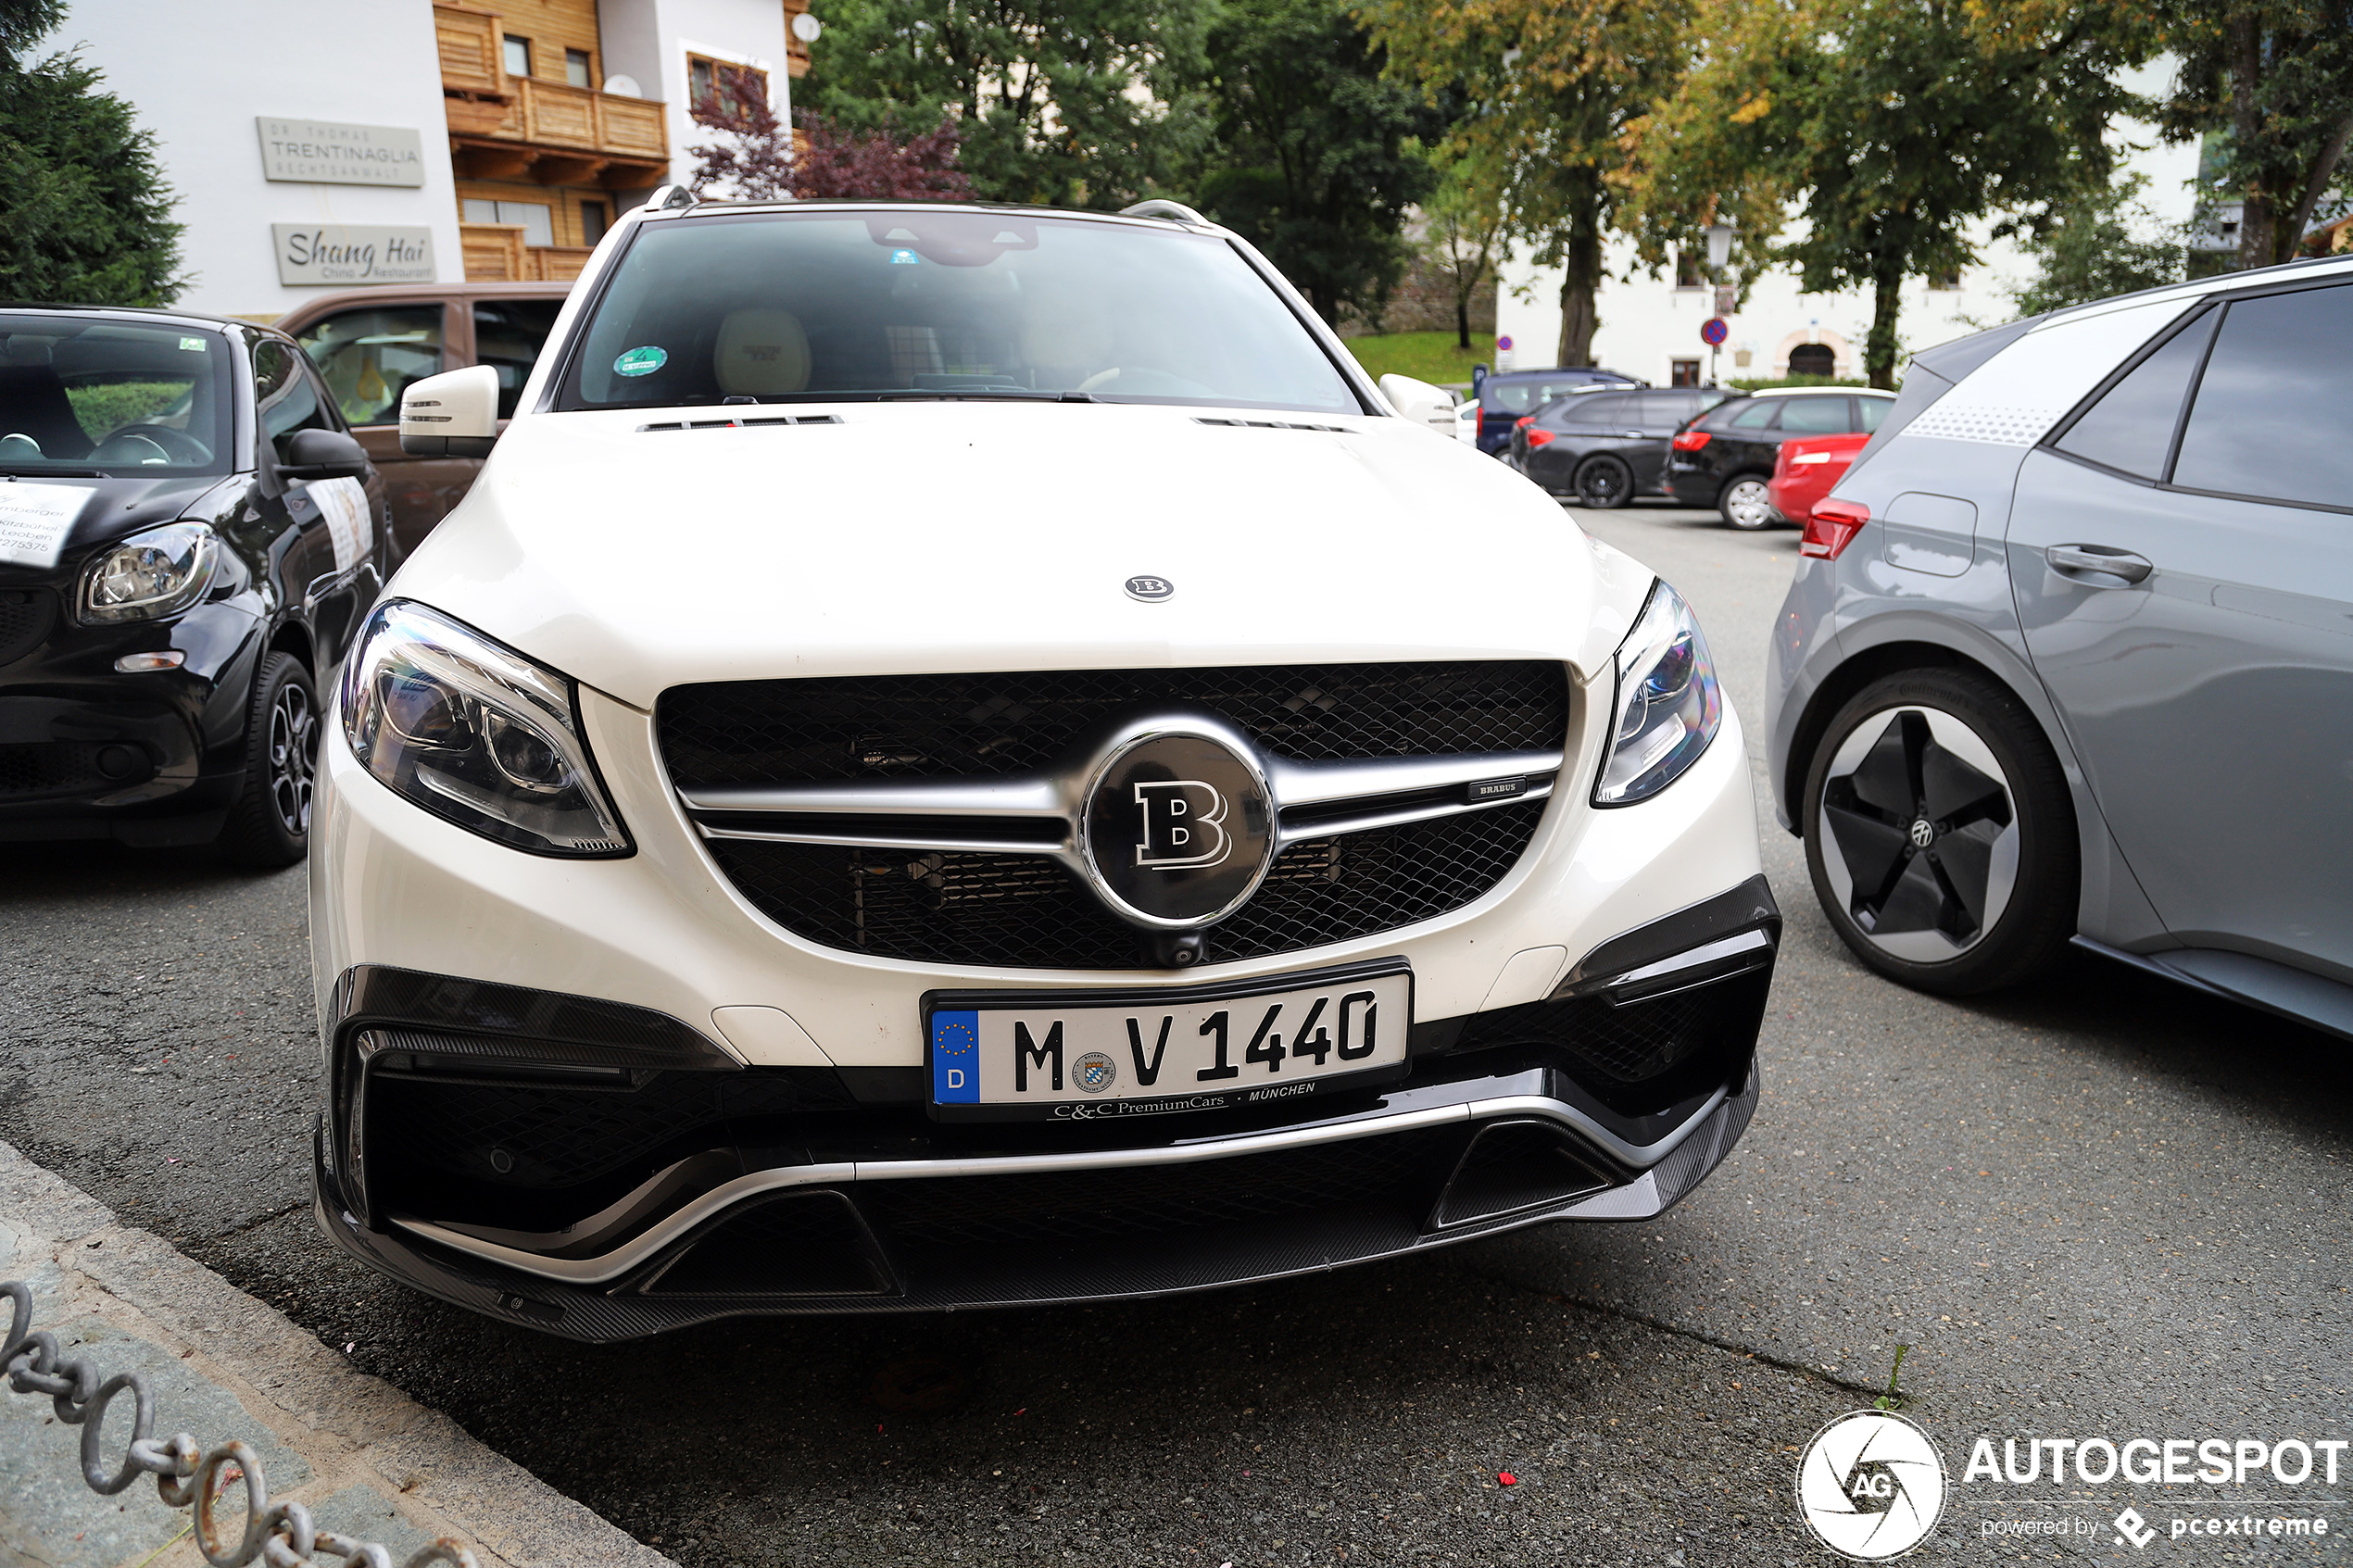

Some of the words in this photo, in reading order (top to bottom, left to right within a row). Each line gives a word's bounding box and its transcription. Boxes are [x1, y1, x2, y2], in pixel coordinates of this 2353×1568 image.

[307, 126, 371, 143] THOMAS
[271, 141, 419, 163] TRENTINAGLIA
[277, 161, 399, 180] RECHTSANWALT
[288, 230, 375, 277] Shang
[385, 236, 426, 263] Hai
[321, 266, 356, 279] China
[373, 266, 433, 279] Restaurant
[635, 350, 648, 362] 4
[2, 529, 53, 542] Leoben
[1131, 578, 1168, 594] B
[1479, 783, 1516, 795] BRABUS
[1134, 780, 1233, 872] B
[1014, 1020, 1064, 1092] M
[948, 1069, 965, 1088] D
[1053, 1103, 1113, 1120] C&C
[1117, 1095, 1225, 1114] PremiumCars
[1249, 1082, 1315, 1102] MÜNCHEN
